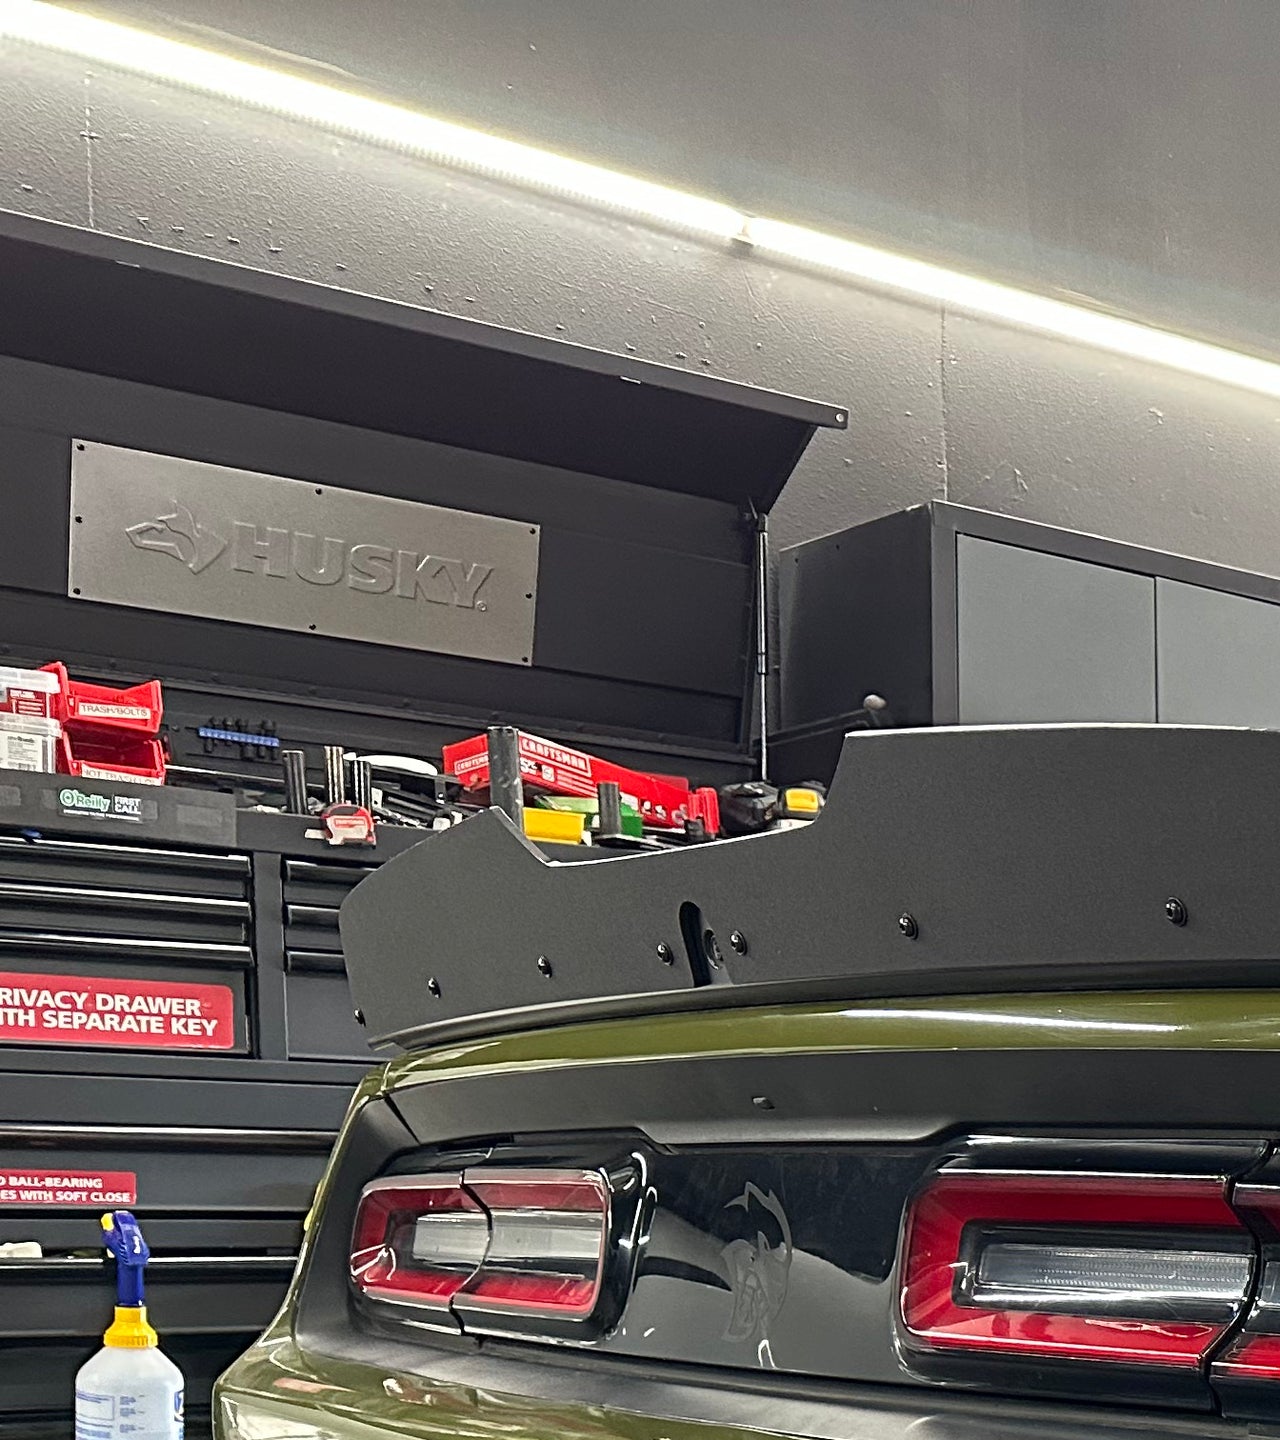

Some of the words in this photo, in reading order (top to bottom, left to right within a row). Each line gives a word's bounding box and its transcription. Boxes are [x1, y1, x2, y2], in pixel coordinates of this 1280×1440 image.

[232, 521, 493, 609] HUSKY
[456, 755, 489, 771] CRAFTSMA
[521, 738, 587, 770] CRAFTSMAN
[95, 994, 201, 1016] DRAWER
[42, 1011, 165, 1034] SEPARATE
[171, 1017, 218, 1037] KEY
[8, 1176, 103, 1188] BALL-BEARING
[18, 1190, 53, 1201] WITH
[55, 1191, 88, 1202] SOFT
[90, 1192, 130, 1203] CLOSE
